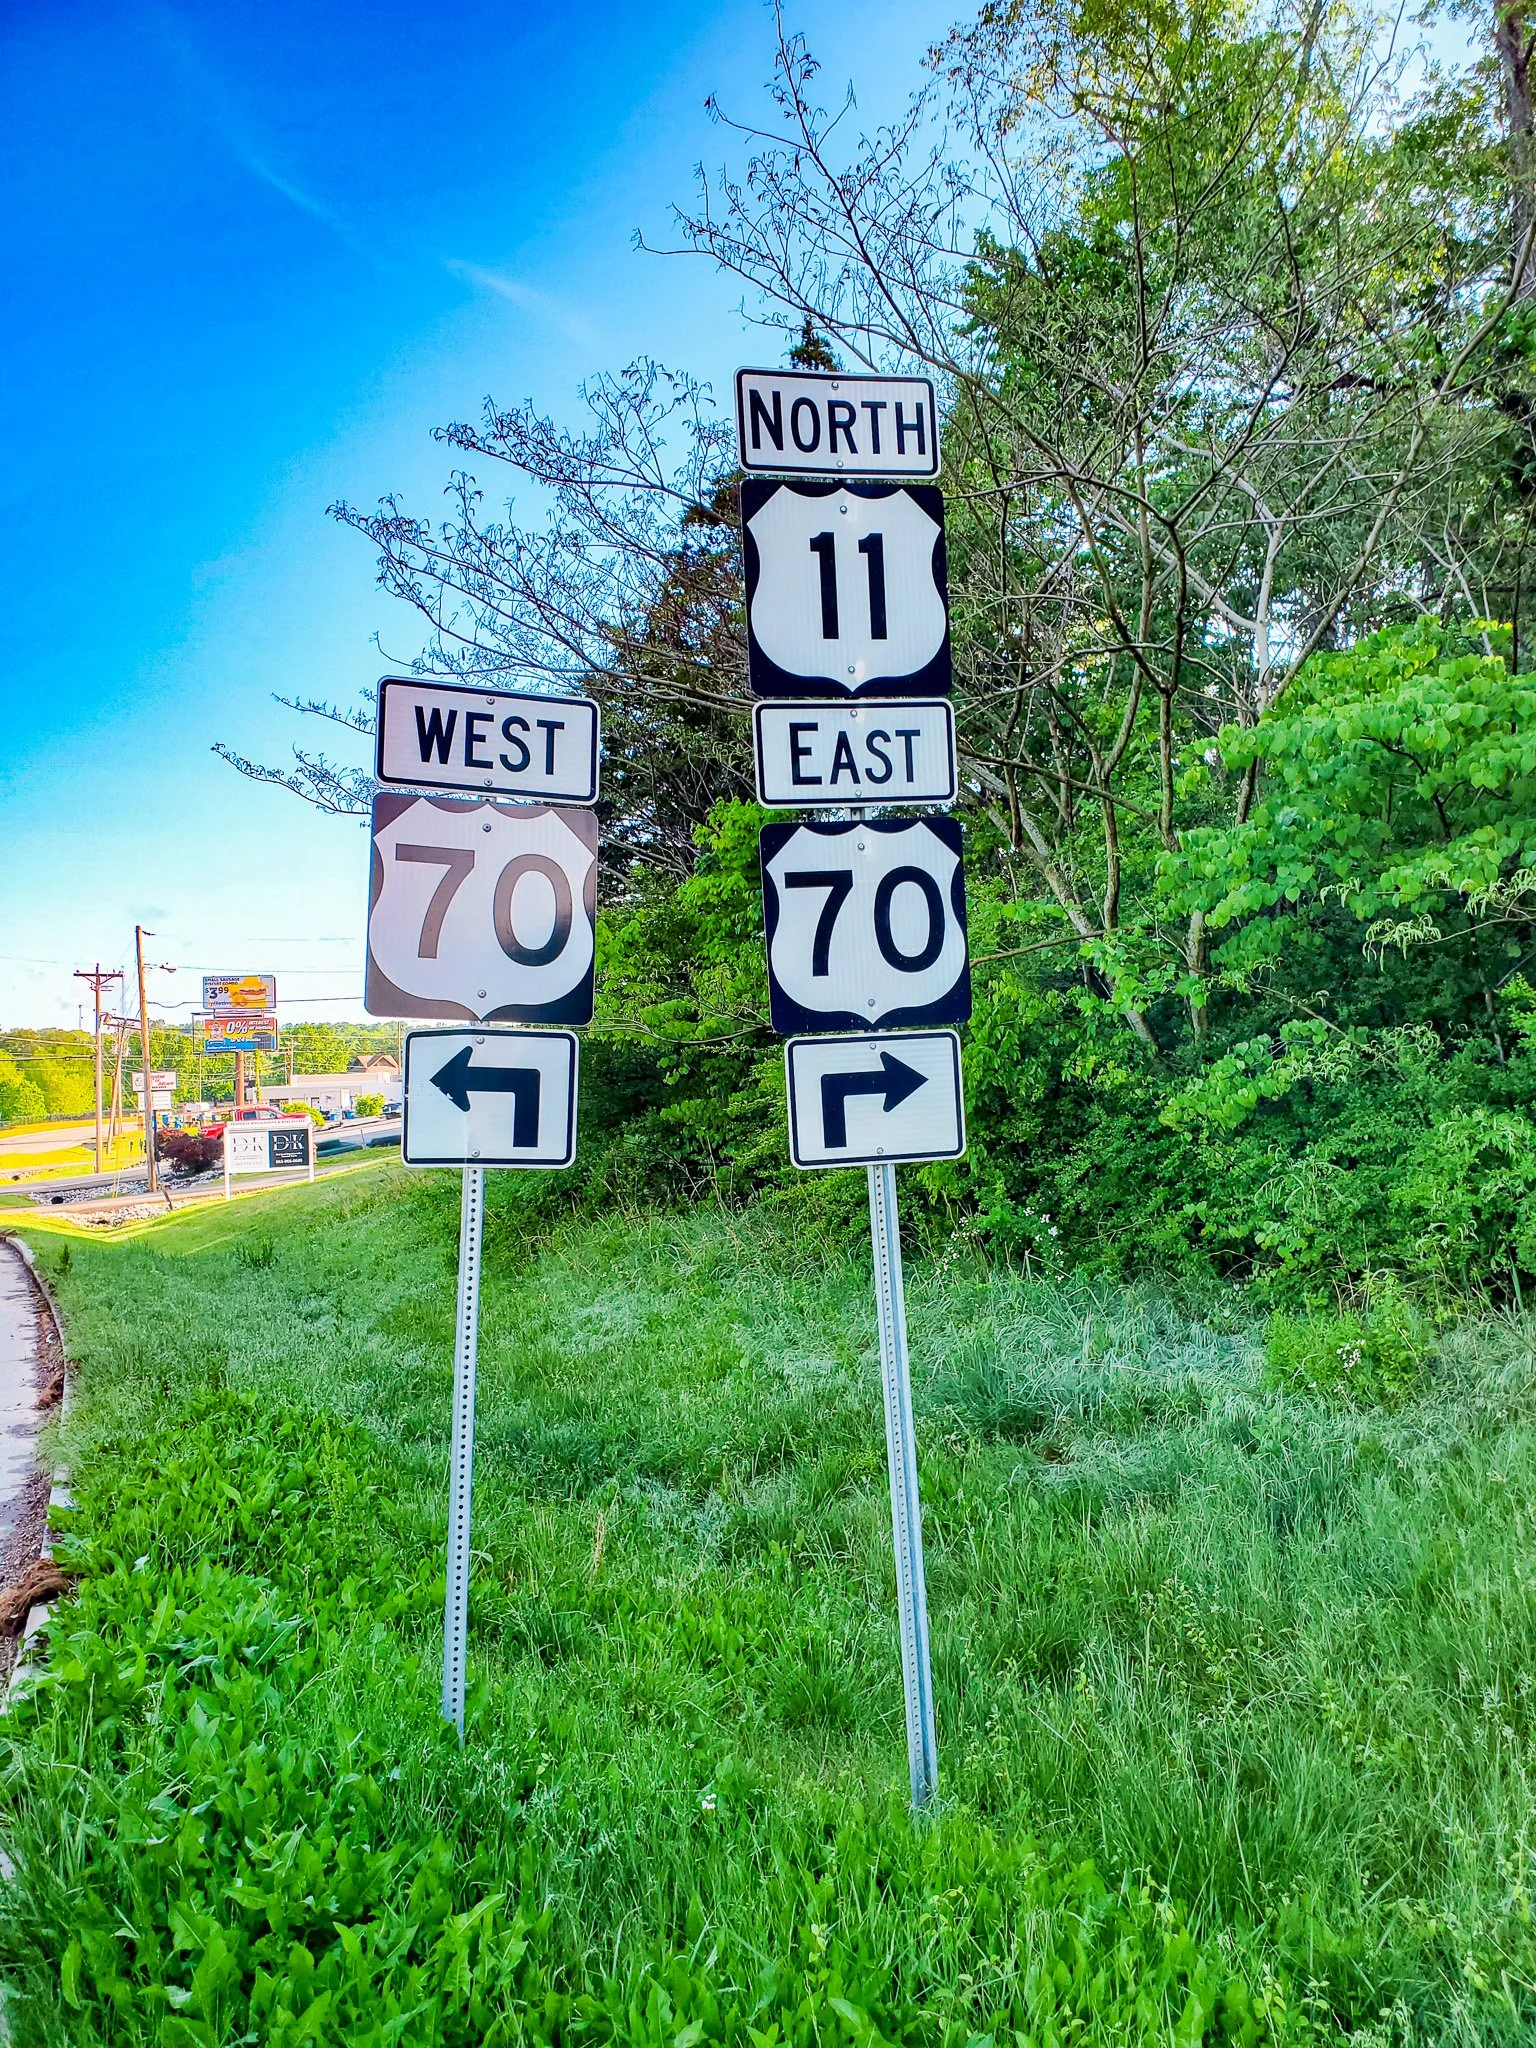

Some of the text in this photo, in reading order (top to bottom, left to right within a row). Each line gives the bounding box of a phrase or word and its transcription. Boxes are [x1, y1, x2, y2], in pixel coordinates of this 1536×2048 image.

[749, 388, 926, 456] NORTH
[809, 531, 887, 641] 11
[414, 705, 565, 776] WEST
[789, 722, 921, 786] EAST
[395, 843, 573, 967] 70
[785, 865, 946, 977] 70
[226, 1020, 248, 1034] 0%
